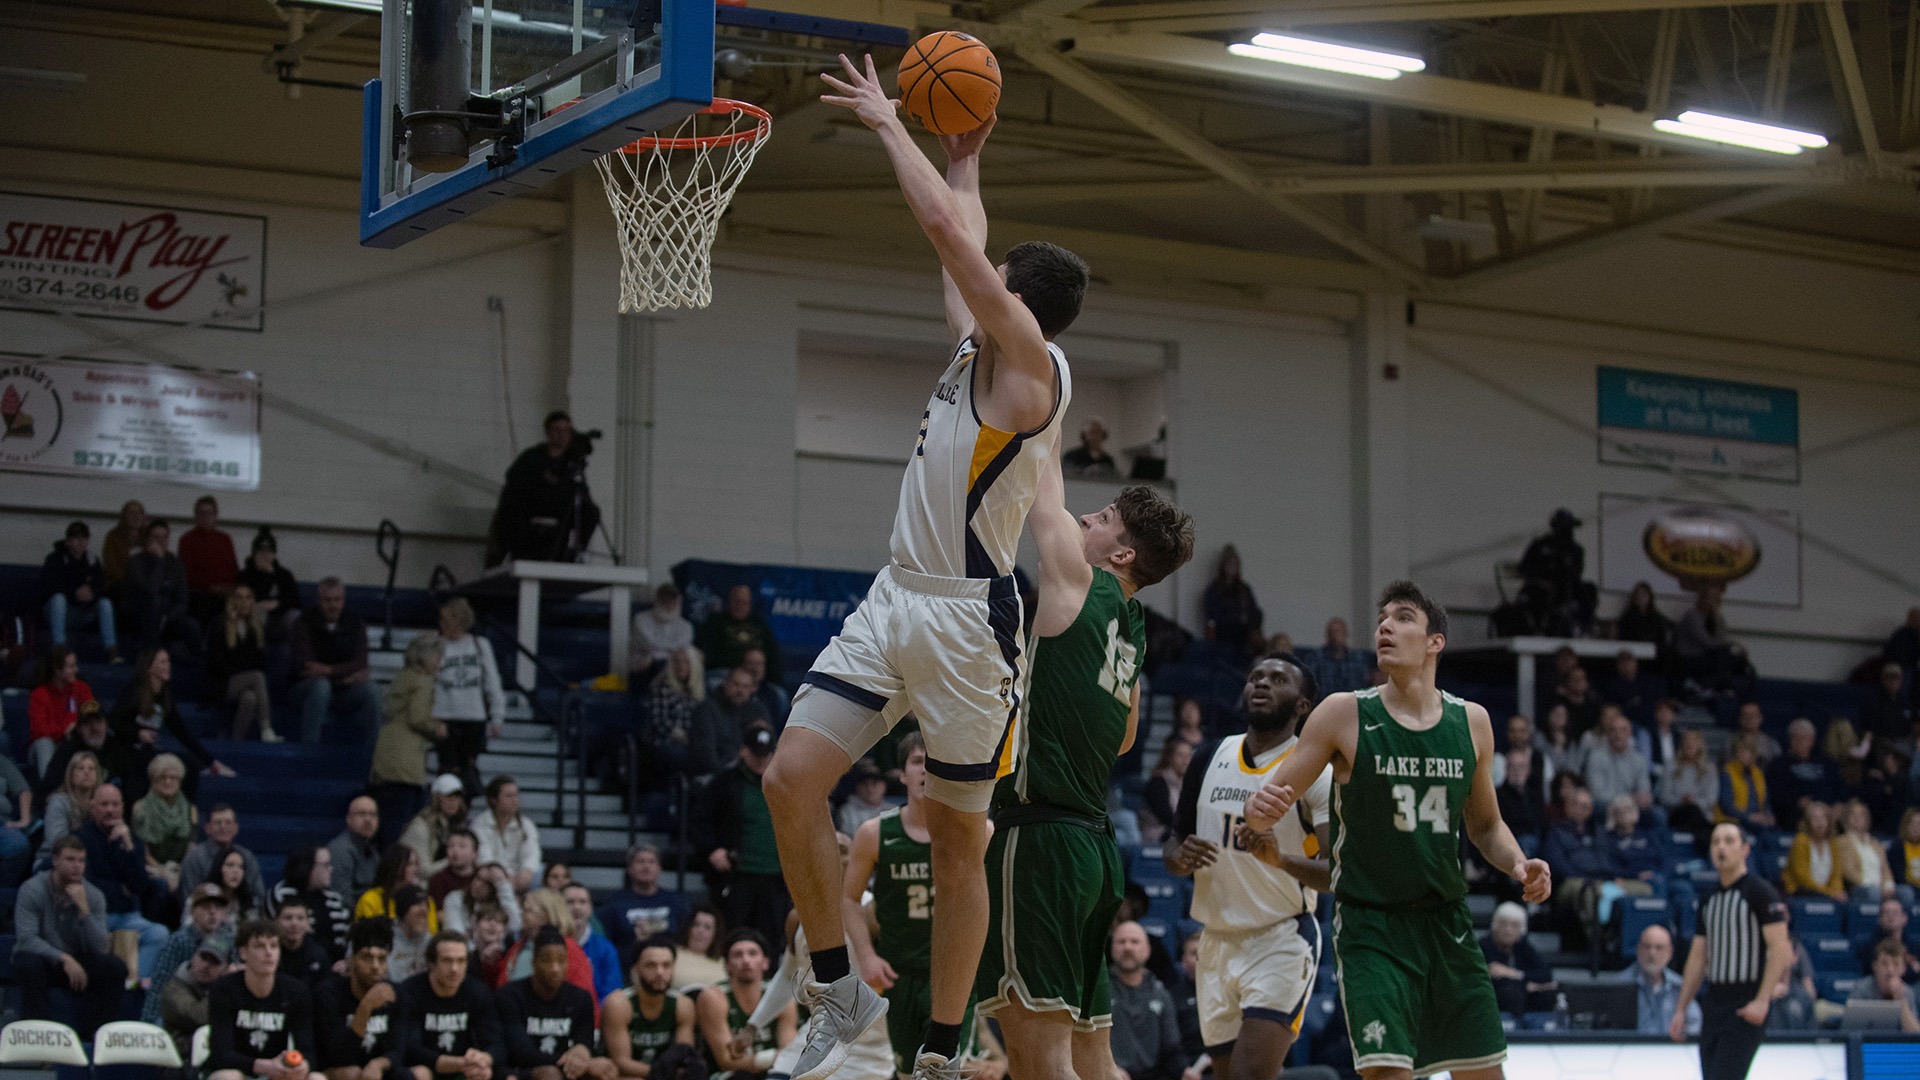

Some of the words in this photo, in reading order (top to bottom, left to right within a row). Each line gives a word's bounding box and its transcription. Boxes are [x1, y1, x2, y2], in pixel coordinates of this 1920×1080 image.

[17, 276, 140, 303] 374-2646
[771, 597, 827, 620] MAKE
[827, 600, 849, 620] IT
[1375, 754, 1420, 778] LAKE
[1424, 756, 1464, 779] ERIE
[1391, 783, 1451, 835] 34
[889, 862, 930, 880] LAKE
[8, 1028, 73, 1047] JACKETS
[105, 1031, 167, 1050] JACKETS
